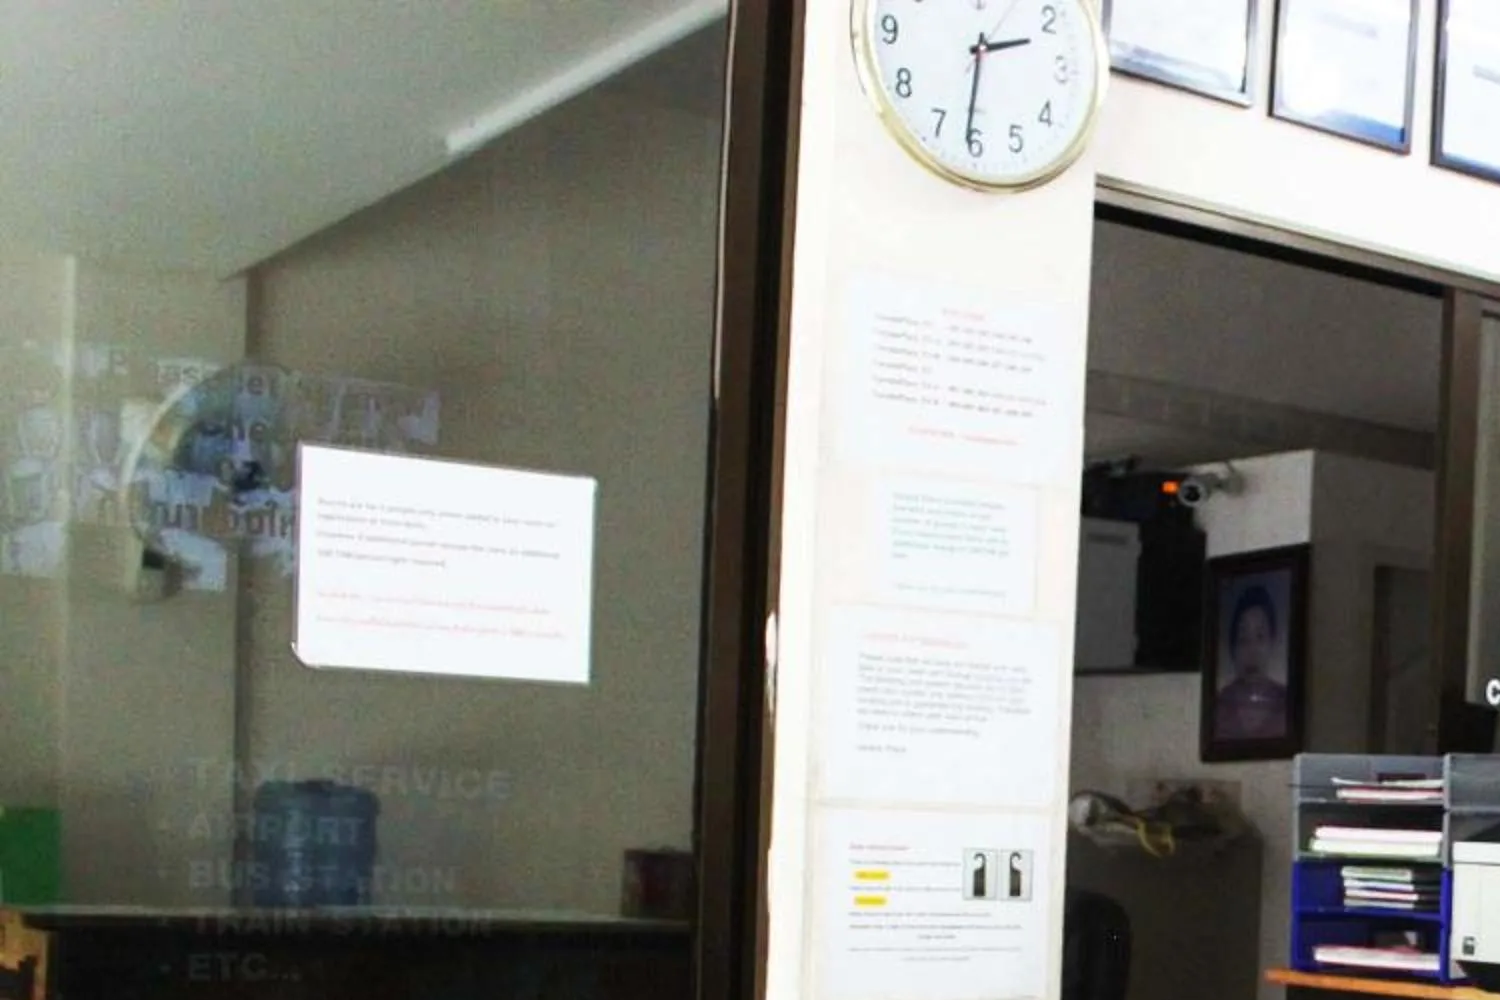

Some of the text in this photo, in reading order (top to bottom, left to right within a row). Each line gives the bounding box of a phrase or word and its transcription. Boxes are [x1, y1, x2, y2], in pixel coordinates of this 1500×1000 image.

[880, 14, 899, 45] 9
[1041, 5, 1057, 35] 2
[895, 67, 913, 99] 8
[1054, 55, 1069, 84] 3
[931, 107, 947, 138] 7
[1037, 100, 1054, 128] 4
[968, 128, 984, 158] 6
[1008, 124, 1024, 153] 5
